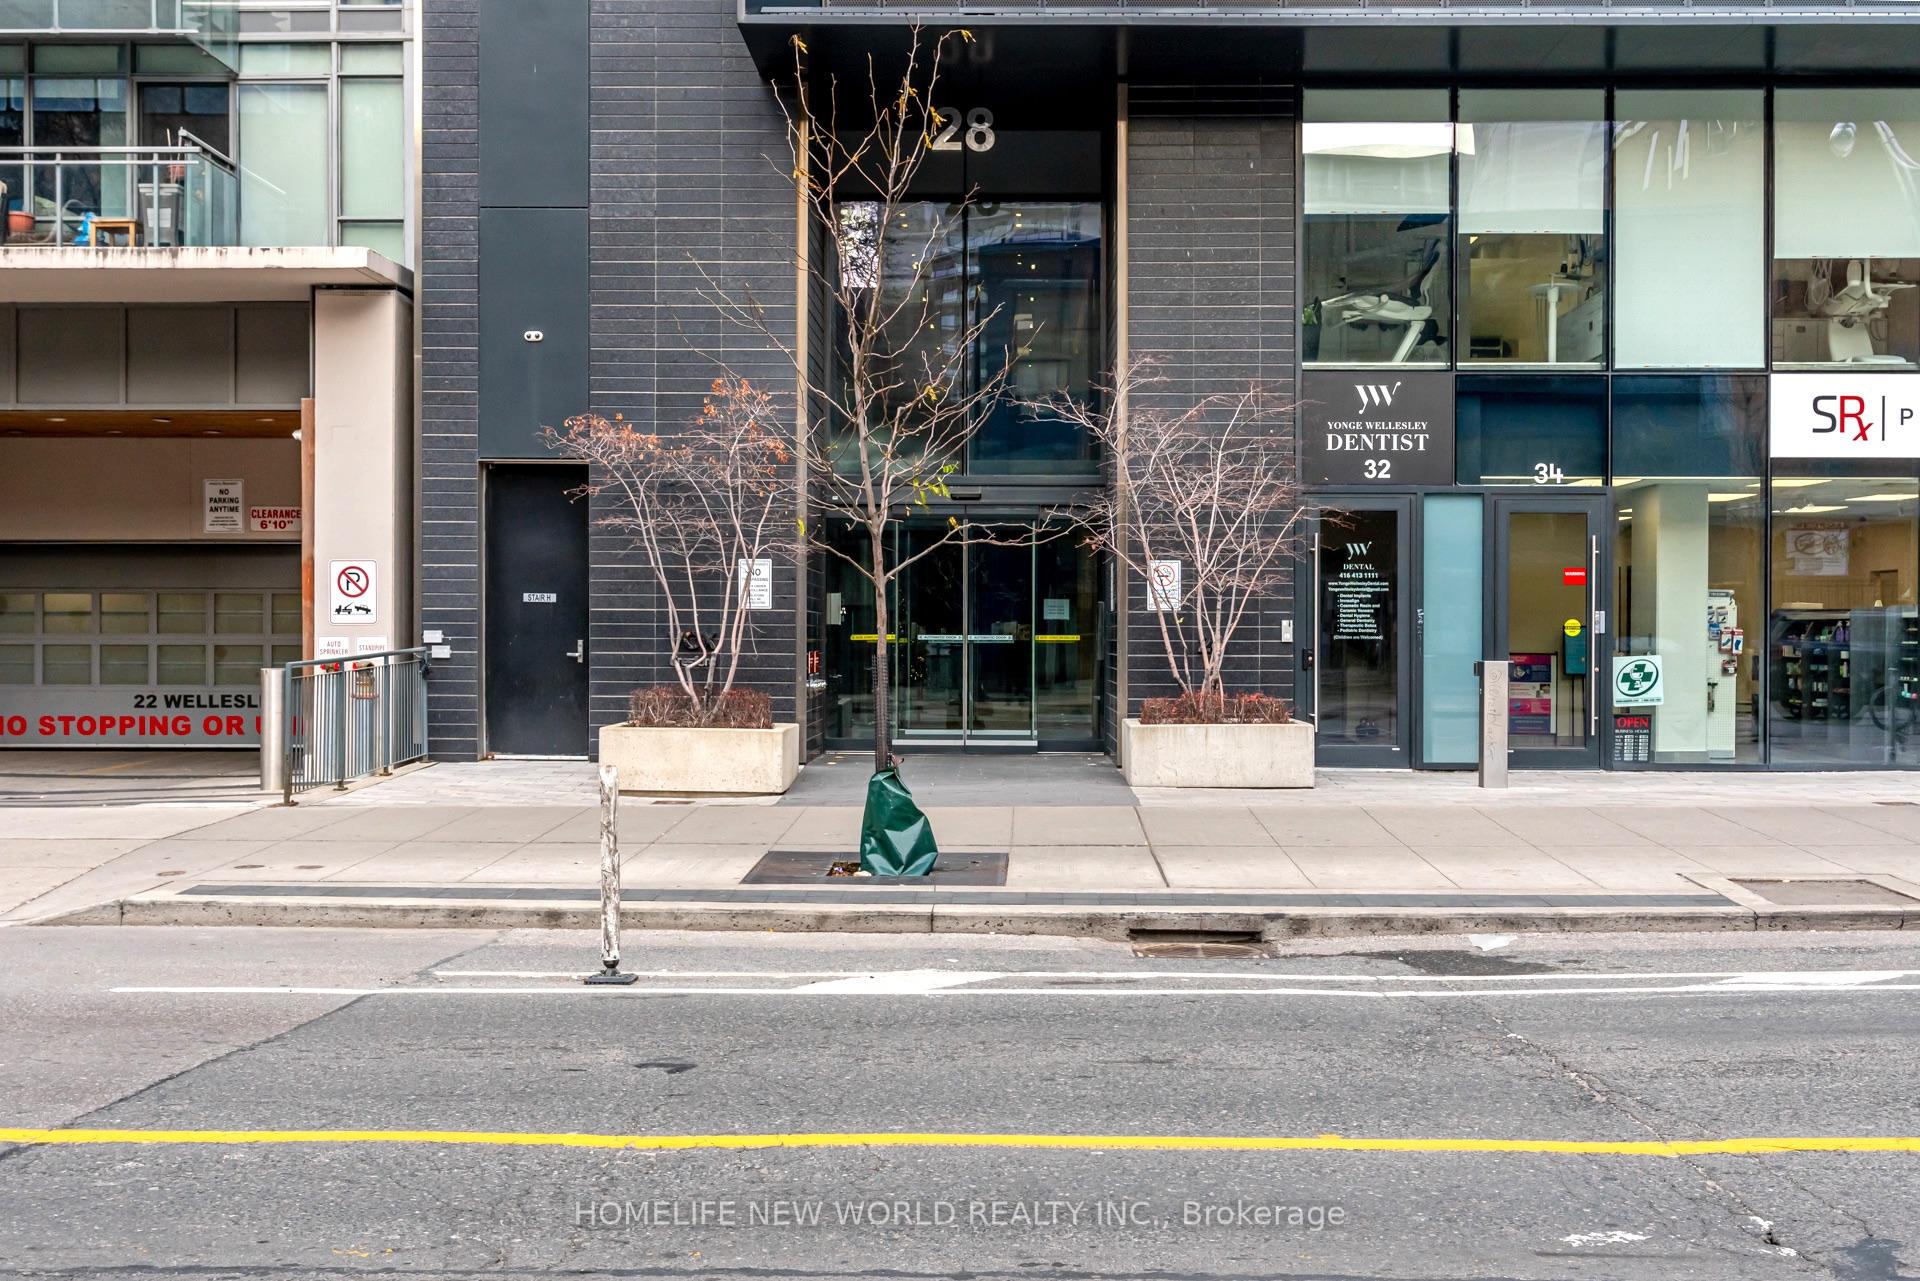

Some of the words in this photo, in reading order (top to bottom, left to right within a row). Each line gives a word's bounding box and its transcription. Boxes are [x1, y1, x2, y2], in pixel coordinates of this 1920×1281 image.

[932, 107, 995, 152] 28
[1327, 421, 1363, 430] YONGE
[1365, 421, 1428, 430] WELLESLEY
[1326, 433, 1429, 451] DENTIST
[1363, 459, 1391, 479] 32
[1533, 463, 1564, 484] 34
[251, 509, 302, 519] CLEARANCE
[527, 593, 545, 602] STAIR
[134, 694, 157, 708] 22
[164, 694, 261, 709] WELLESL
[0, 715, 27, 736] O
[38, 715, 191, 736] STOPPING
[202, 715, 244, 736] OR
[1616, 717, 1649, 729] OPEN
